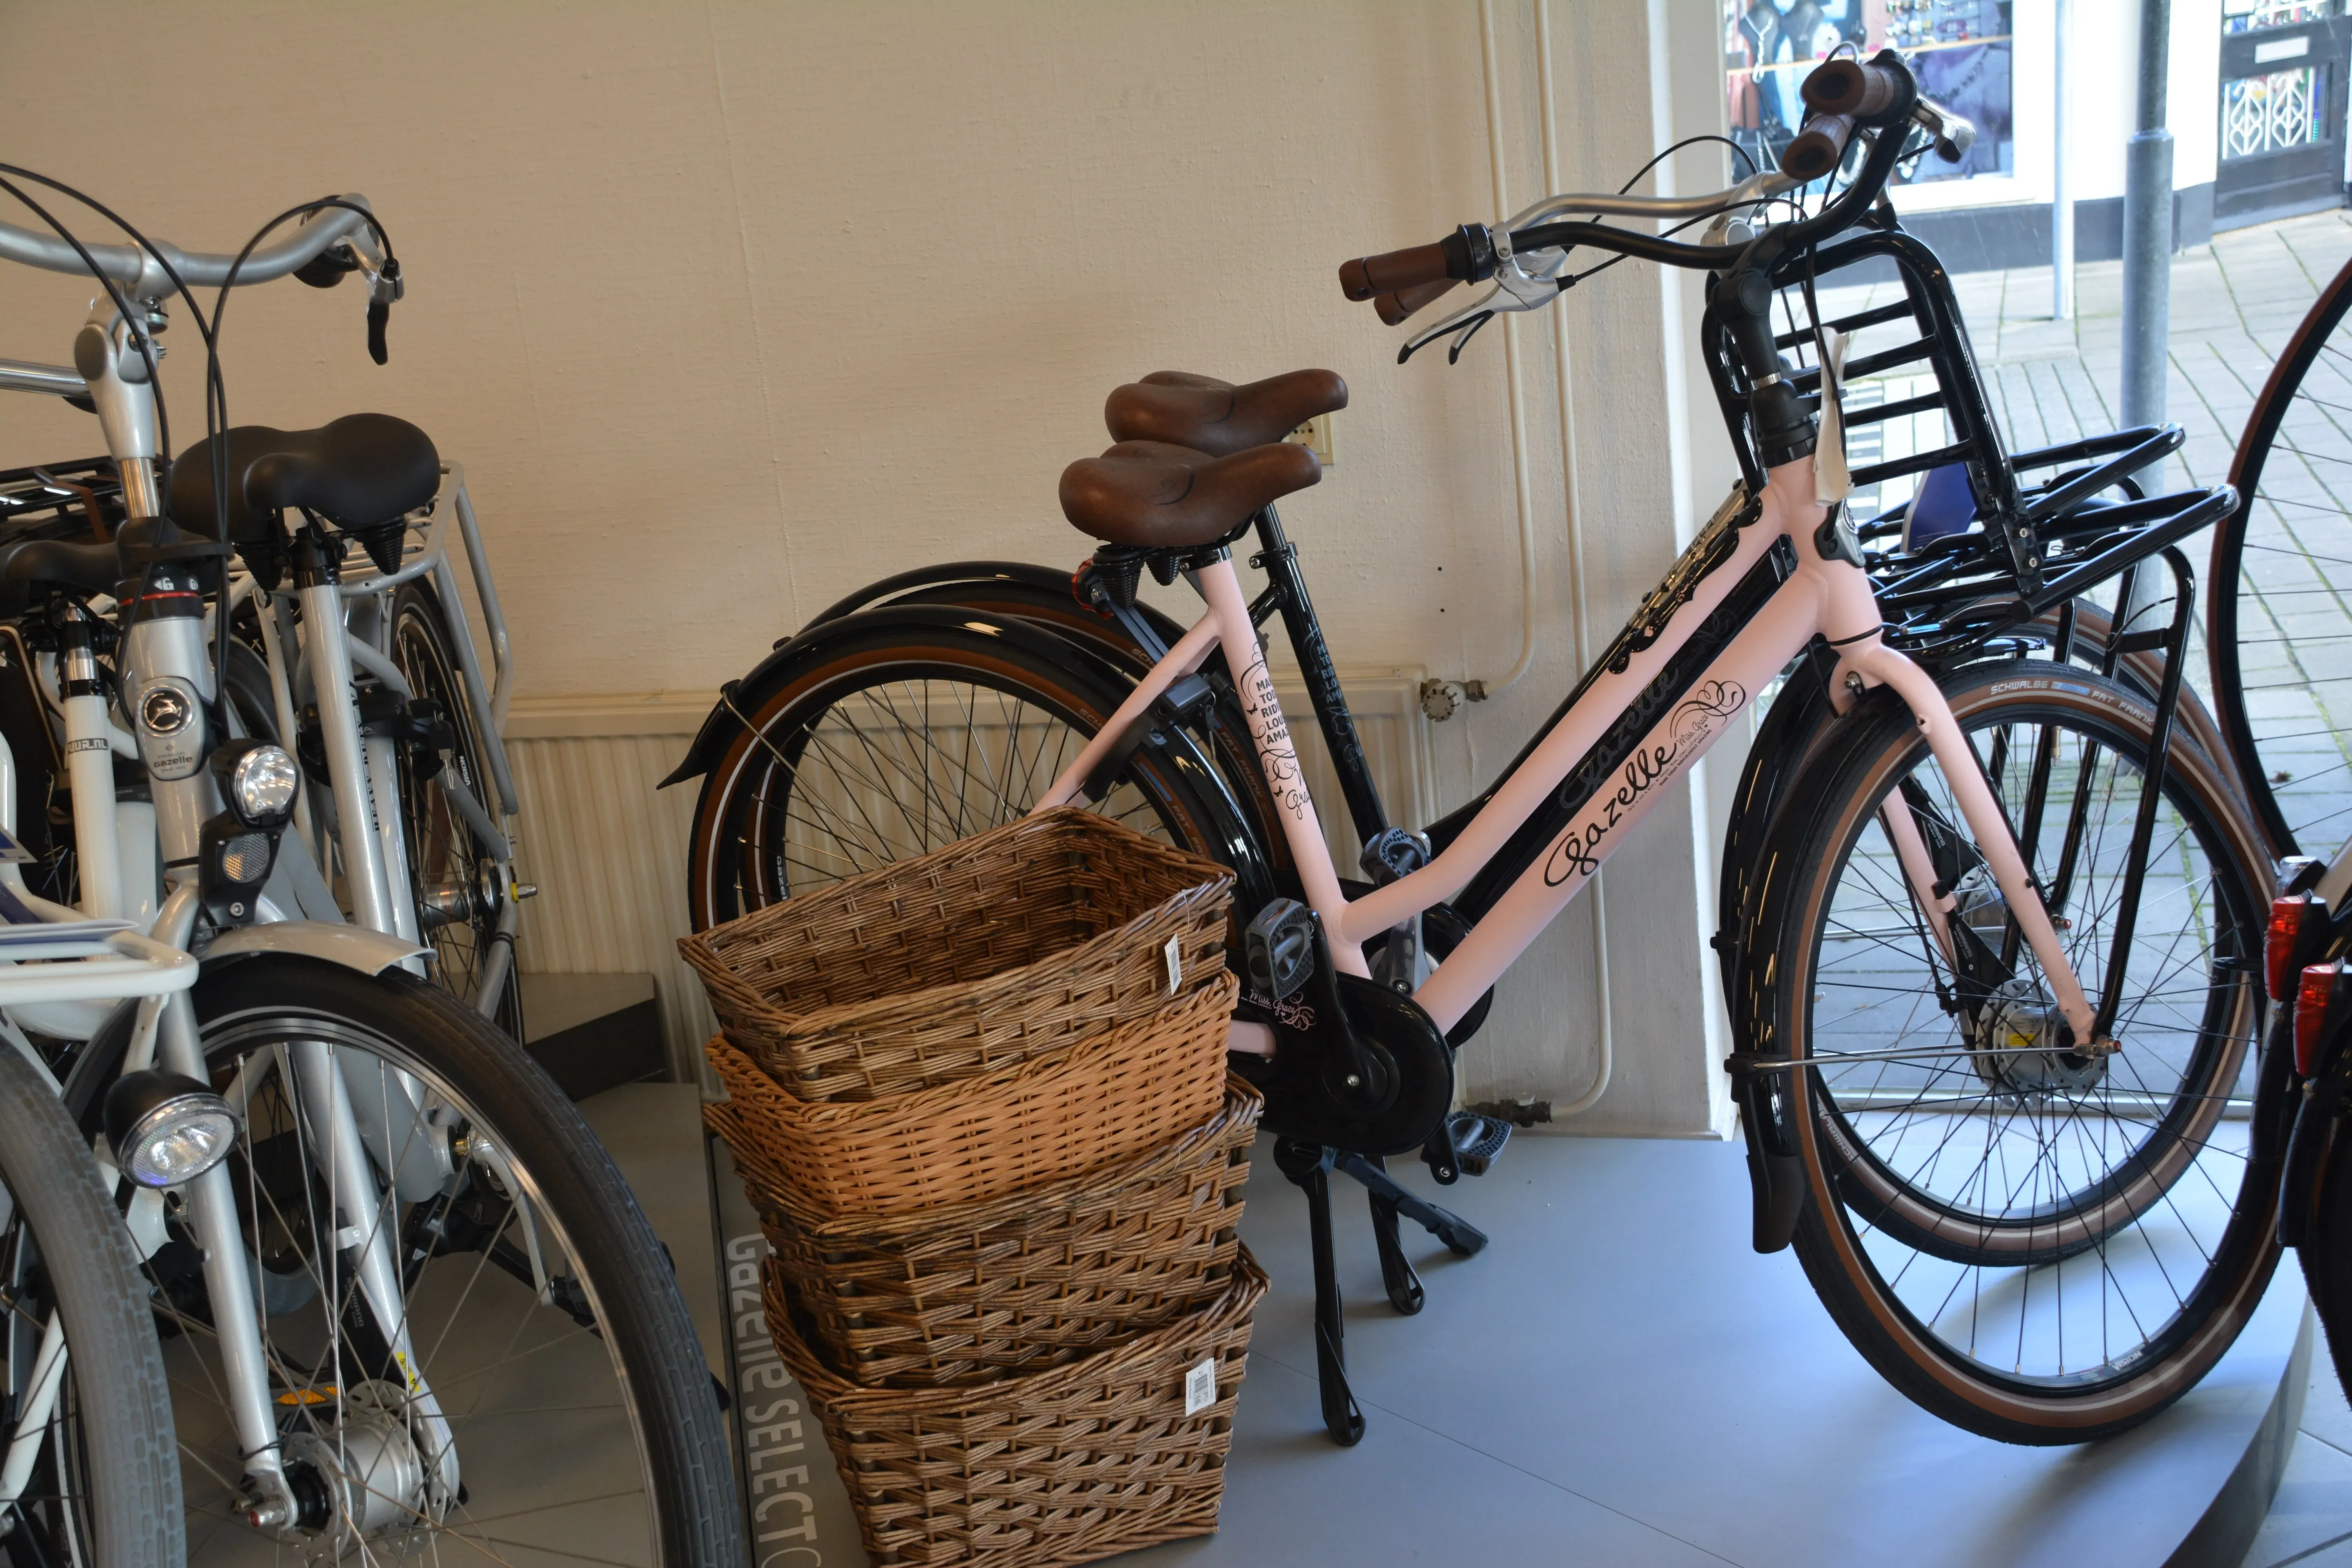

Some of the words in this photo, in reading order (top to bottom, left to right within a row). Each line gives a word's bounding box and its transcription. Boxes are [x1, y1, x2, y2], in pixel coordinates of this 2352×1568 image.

[1991, 681, 2048, 695] SCHWALBE
[2091, 691, 2114, 703] FAT
[2118, 701, 2155, 726] FRANK
[1221, 732, 1240, 753] FAT
[1676, 732, 1695, 746] Miss.
[1692, 714, 1708, 732] Grace
[154, 756, 193, 768] Gazelle
[459, 755, 471, 786] VISION
[1659, 777, 1669, 786] MAKE
[1668, 766, 1678, 777] TODAY
[1677, 744, 1698, 766] RIDICULOUSLY
[1698, 729, 1712, 745] AMAZING
[1172, 805, 1191, 829] FAT
[1544, 742, 1677, 887] Gazelle
[1250, 989, 1271, 1006] Miss.
[1273, 1000, 1296, 1016] Grace
[727, 1233, 793, 1394] Gazelle
[2112, 1350, 2143, 1371] VISION
[745, 1398, 817, 1543] SELECT
